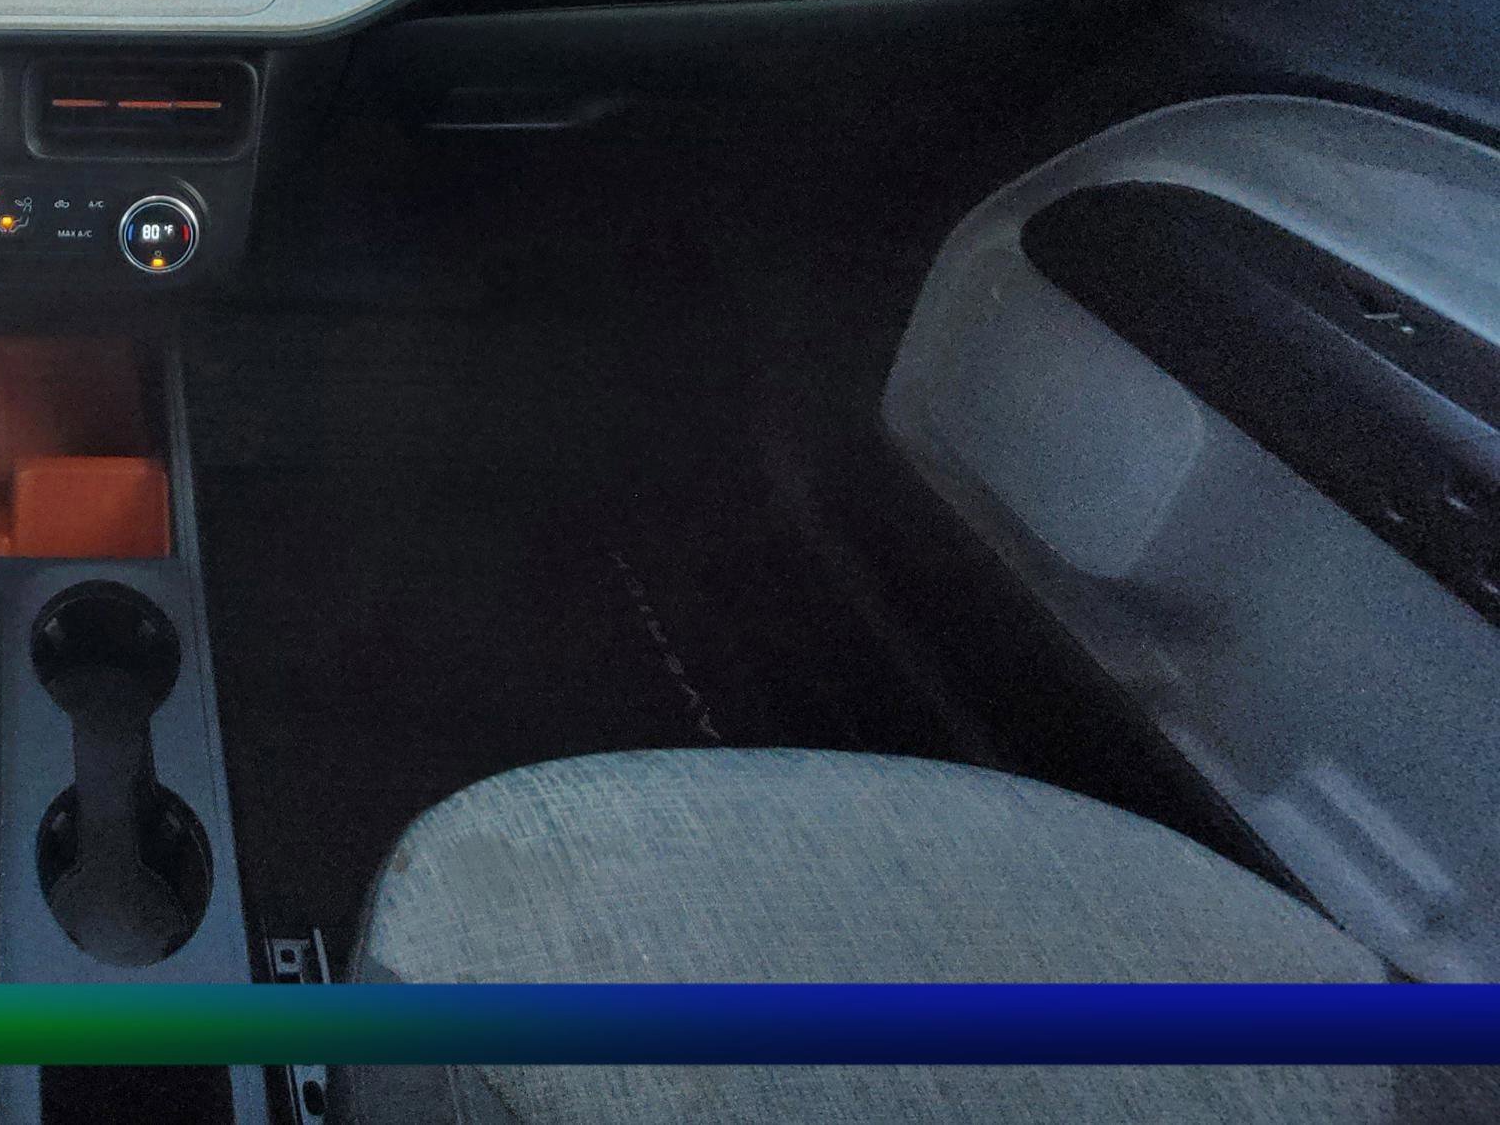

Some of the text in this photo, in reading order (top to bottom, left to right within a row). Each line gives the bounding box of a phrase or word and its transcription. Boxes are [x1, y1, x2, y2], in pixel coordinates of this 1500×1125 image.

[88, 200, 105, 209] A/C
[57, 229, 93, 238] MAX A/C
[142, 224, 160, 240] 80
